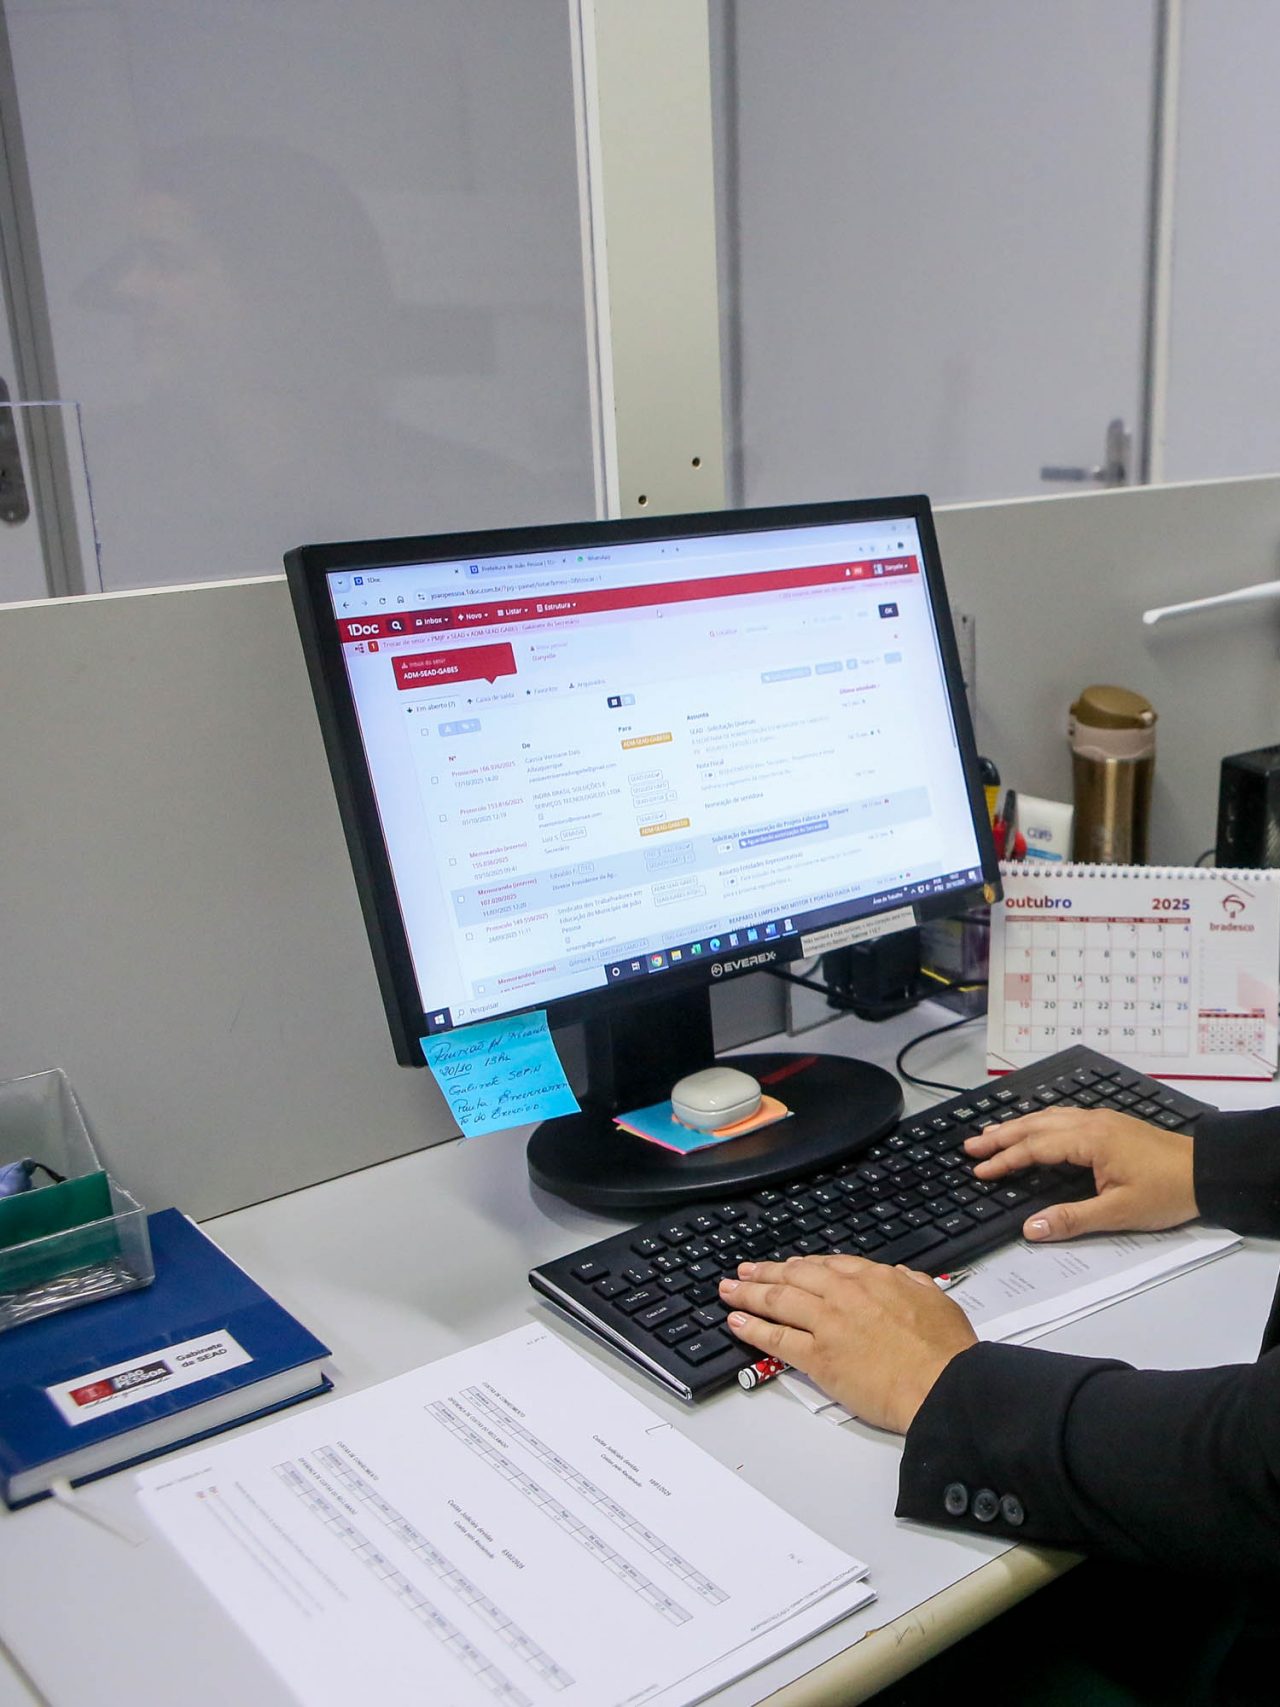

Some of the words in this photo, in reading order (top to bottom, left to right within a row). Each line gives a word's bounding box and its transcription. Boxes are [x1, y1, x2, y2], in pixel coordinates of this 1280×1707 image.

[504, 607, 522, 616] Listar
[543, 602, 571, 611] Estrutura
[423, 616, 442, 625] Inbox
[464, 612, 483, 620] Novo
[346, 621, 380, 636] 1Doc
[403, 666, 458, 680] ADM-SEAD-GABES
[1005, 895, 1072, 909] outubro
[1152, 898, 1190, 910] 2025
[1210, 922, 1254, 932] bradesco
[724, 951, 774, 972] EVEREX
[470, 1001, 498, 1015] Pesquisar
[176, 1342, 222, 1362] Gabinete
[197, 1348, 227, 1362] SEAD
[117, 1368, 166, 1388] PESSOA
